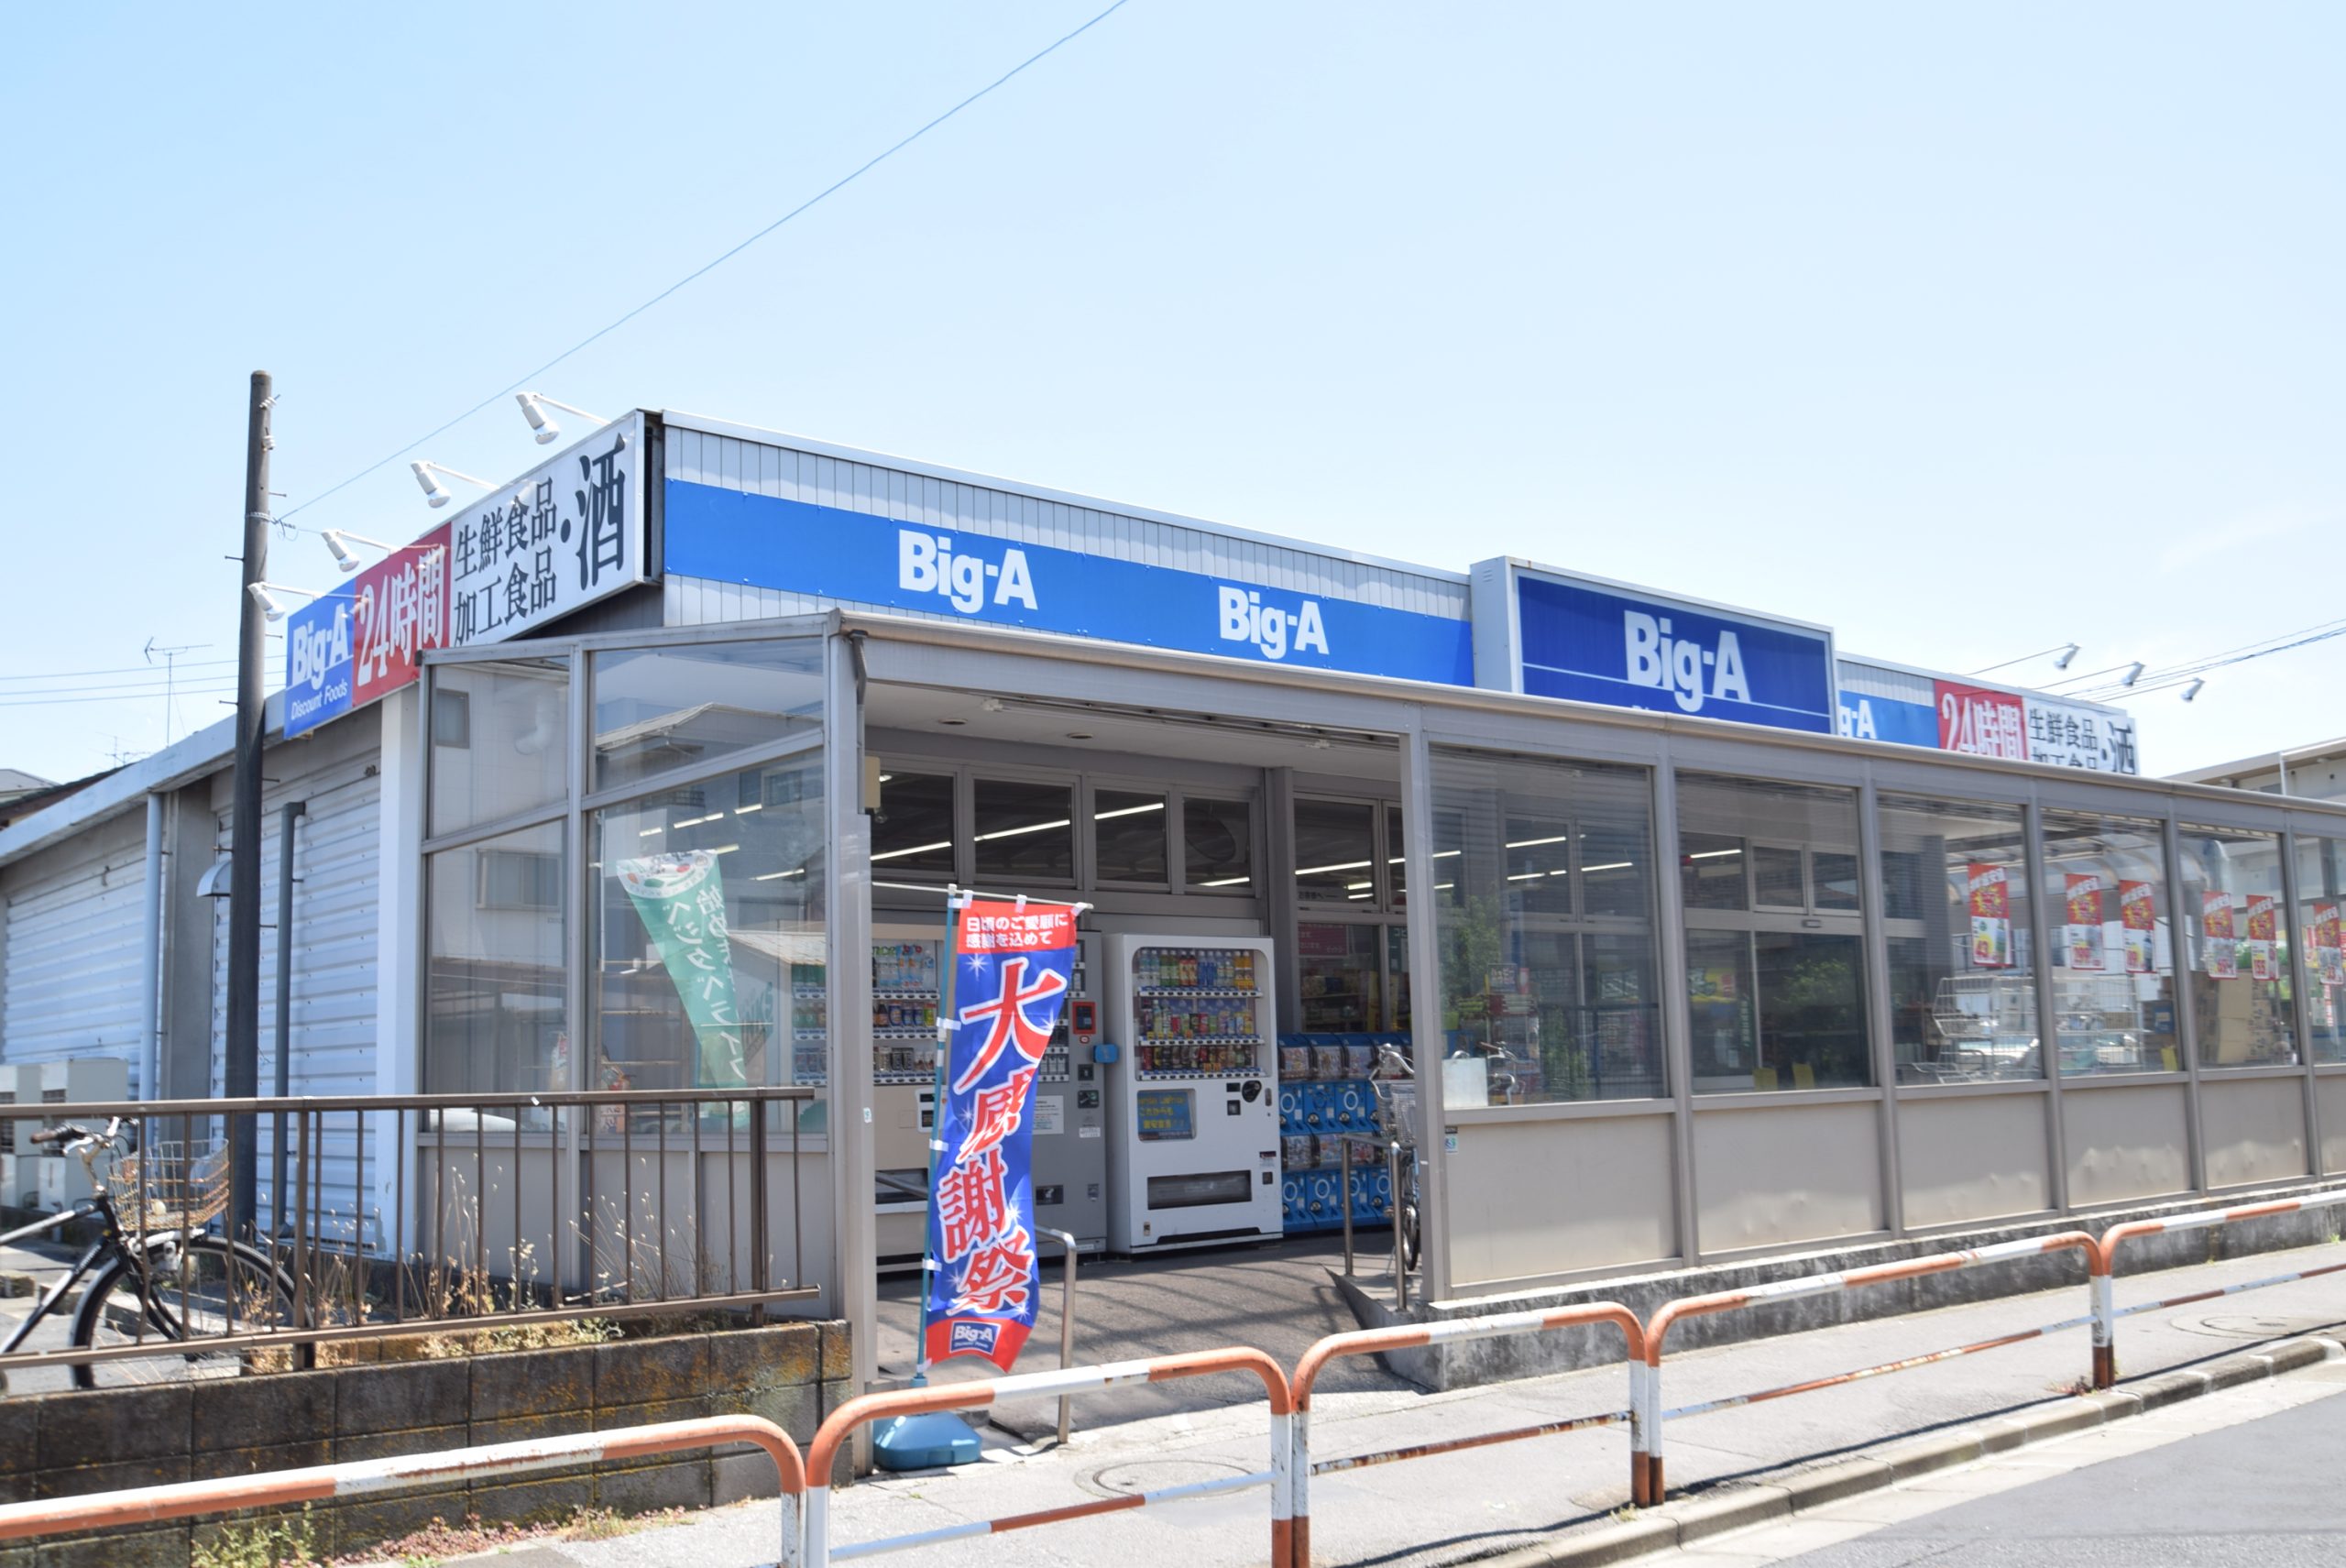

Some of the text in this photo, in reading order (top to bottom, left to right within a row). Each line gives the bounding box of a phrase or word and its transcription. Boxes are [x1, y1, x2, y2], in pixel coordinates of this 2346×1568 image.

[455, 477, 557, 582] 生鮮食品
[898, 529, 1039, 614] Big-A
[357, 543, 445, 686] 24時間
[455, 545, 557, 647] 加工食品
[1218, 586, 1330, 660] Big-A
[291, 602, 349, 690] Big-A
[1624, 609, 1752, 713] Big-A
[291, 678, 348, 720] Discount Foods
[1941, 693, 2022, 760] 24時間
[2028, 708, 2098, 751] 生鮮食品
[966, 931, 1053, 948] 感謝を込めて
[937, 957, 1068, 1316] 大感謝祭
